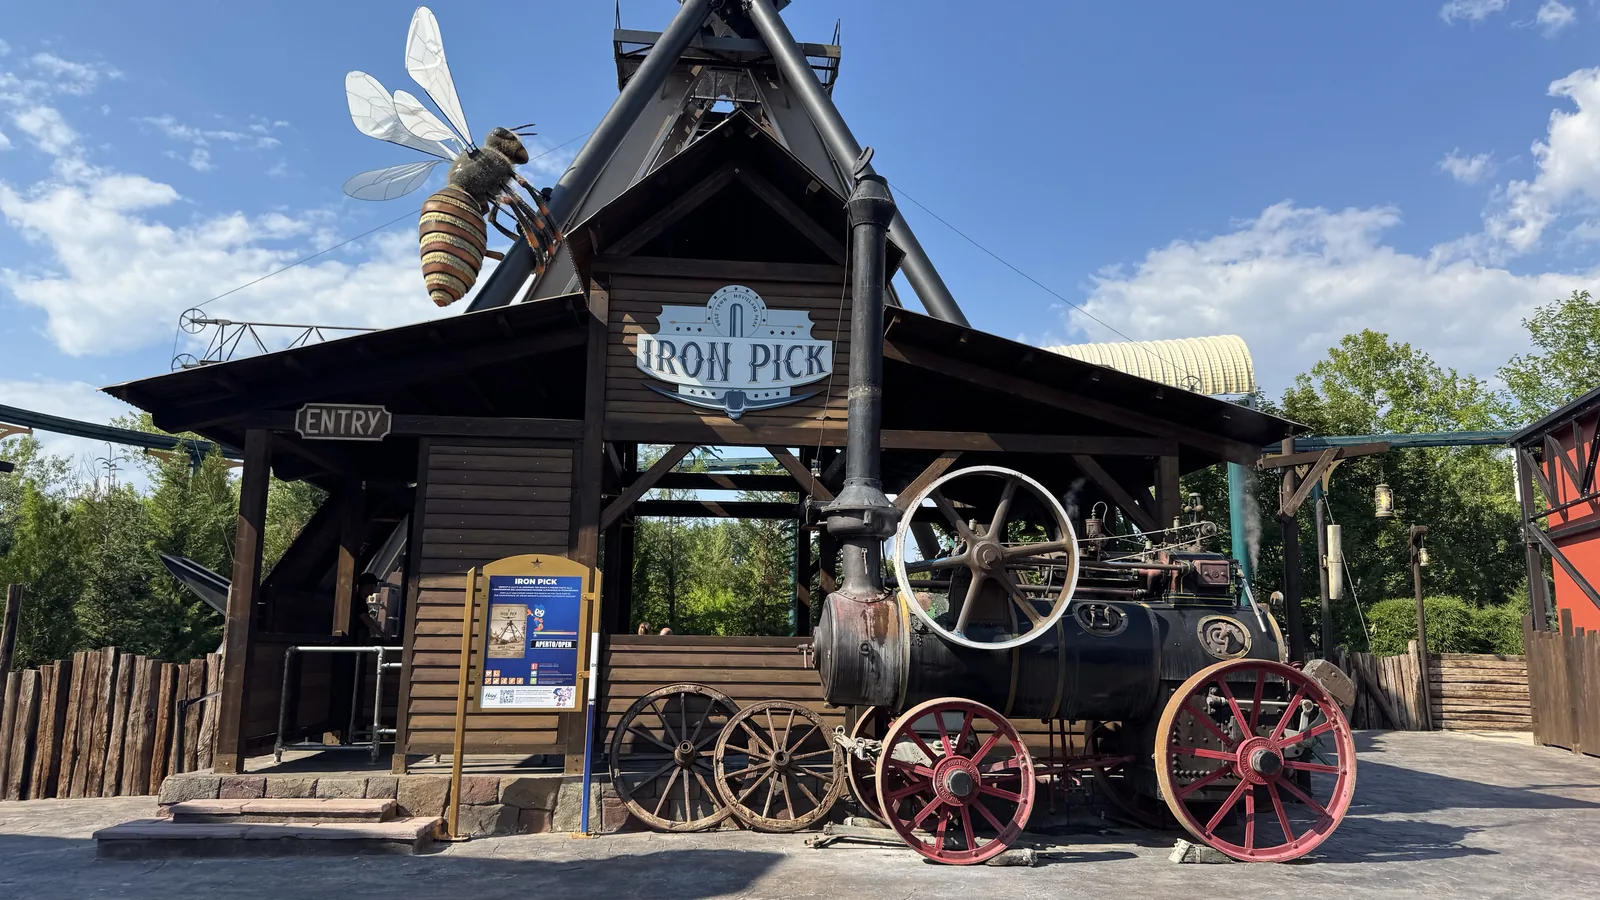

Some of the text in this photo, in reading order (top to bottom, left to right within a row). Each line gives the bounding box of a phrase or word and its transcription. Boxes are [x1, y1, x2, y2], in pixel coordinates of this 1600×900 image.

[642, 338, 829, 383] IRON PICK
[305, 408, 382, 435] ENTRY
[535, 640, 572, 648] APERTO/OPEN
